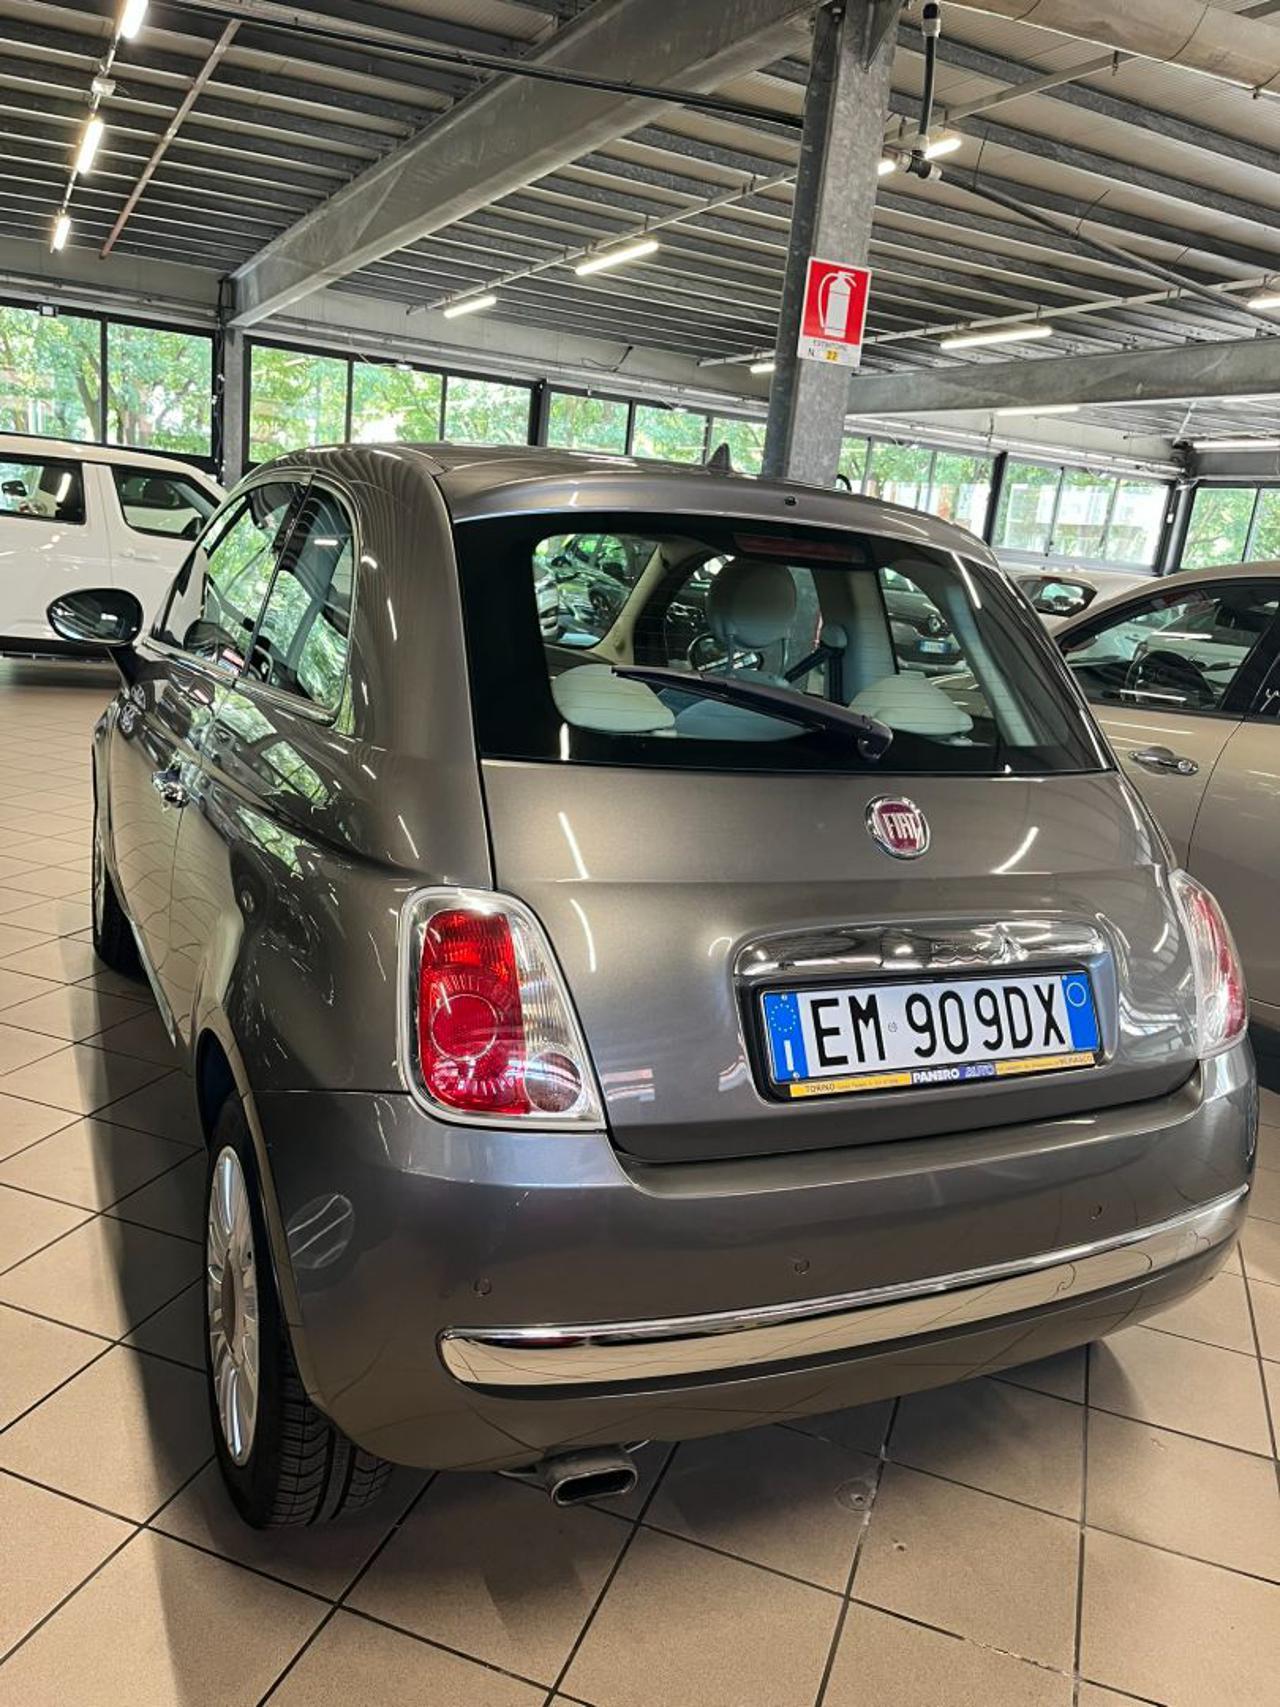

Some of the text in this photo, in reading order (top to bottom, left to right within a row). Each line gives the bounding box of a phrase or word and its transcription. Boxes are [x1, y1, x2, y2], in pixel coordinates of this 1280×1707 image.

[881, 812, 917, 840] FIAT
[810, 983, 1066, 1068] EM 909DX
[912, 1067, 960, 1083] PANERO
[964, 1062, 995, 1078] AUTO
